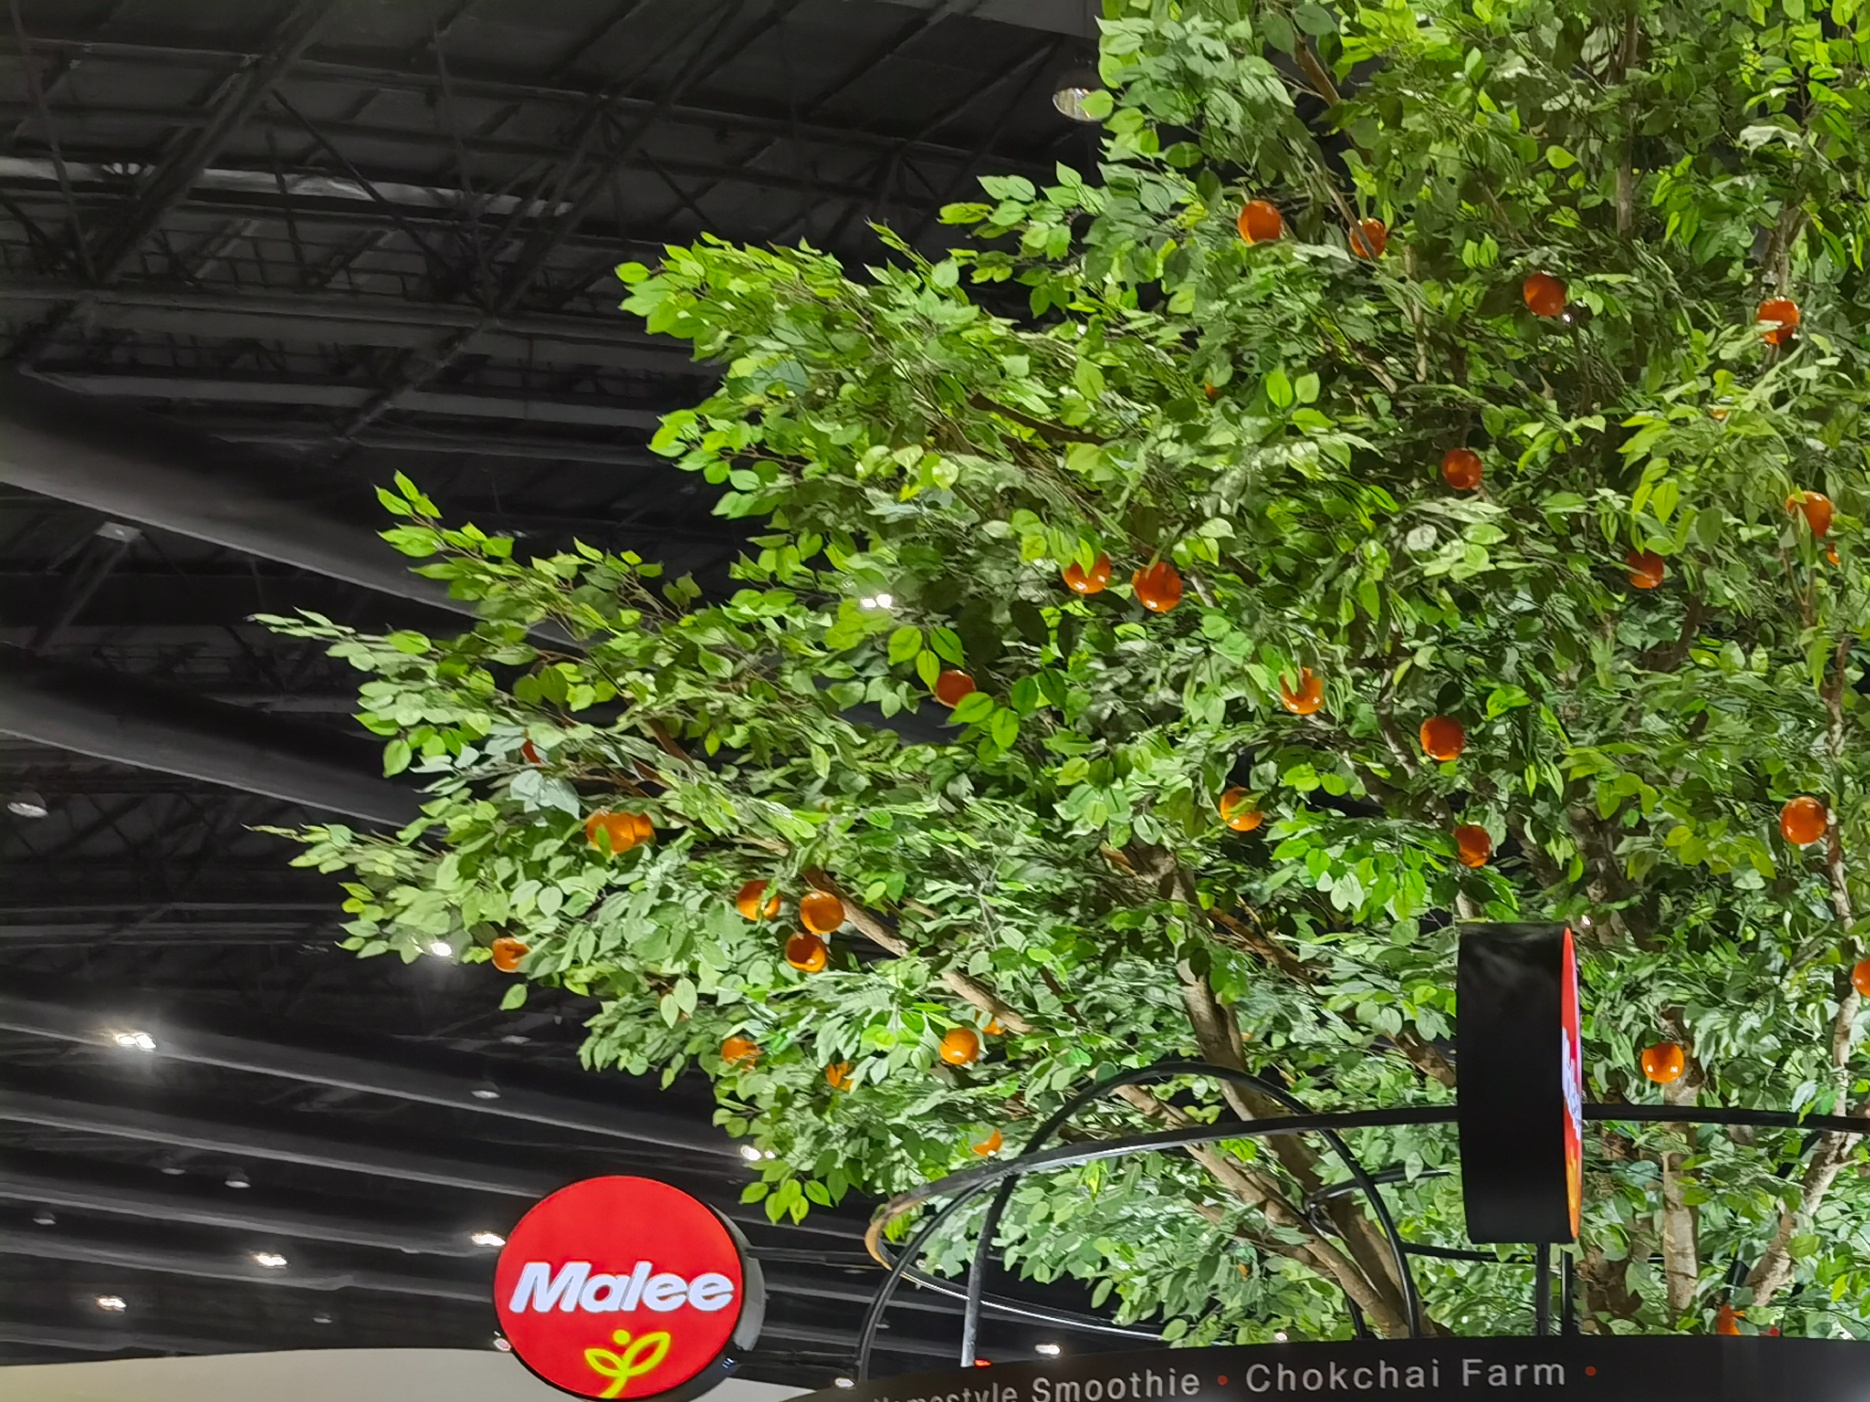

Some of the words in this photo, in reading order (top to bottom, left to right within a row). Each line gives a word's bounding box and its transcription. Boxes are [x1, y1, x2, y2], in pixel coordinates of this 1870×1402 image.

[509, 1261, 734, 1313] Malee
[1245, 1358, 1441, 1393] Chokchai
[1461, 1358, 1566, 1388] Farm
